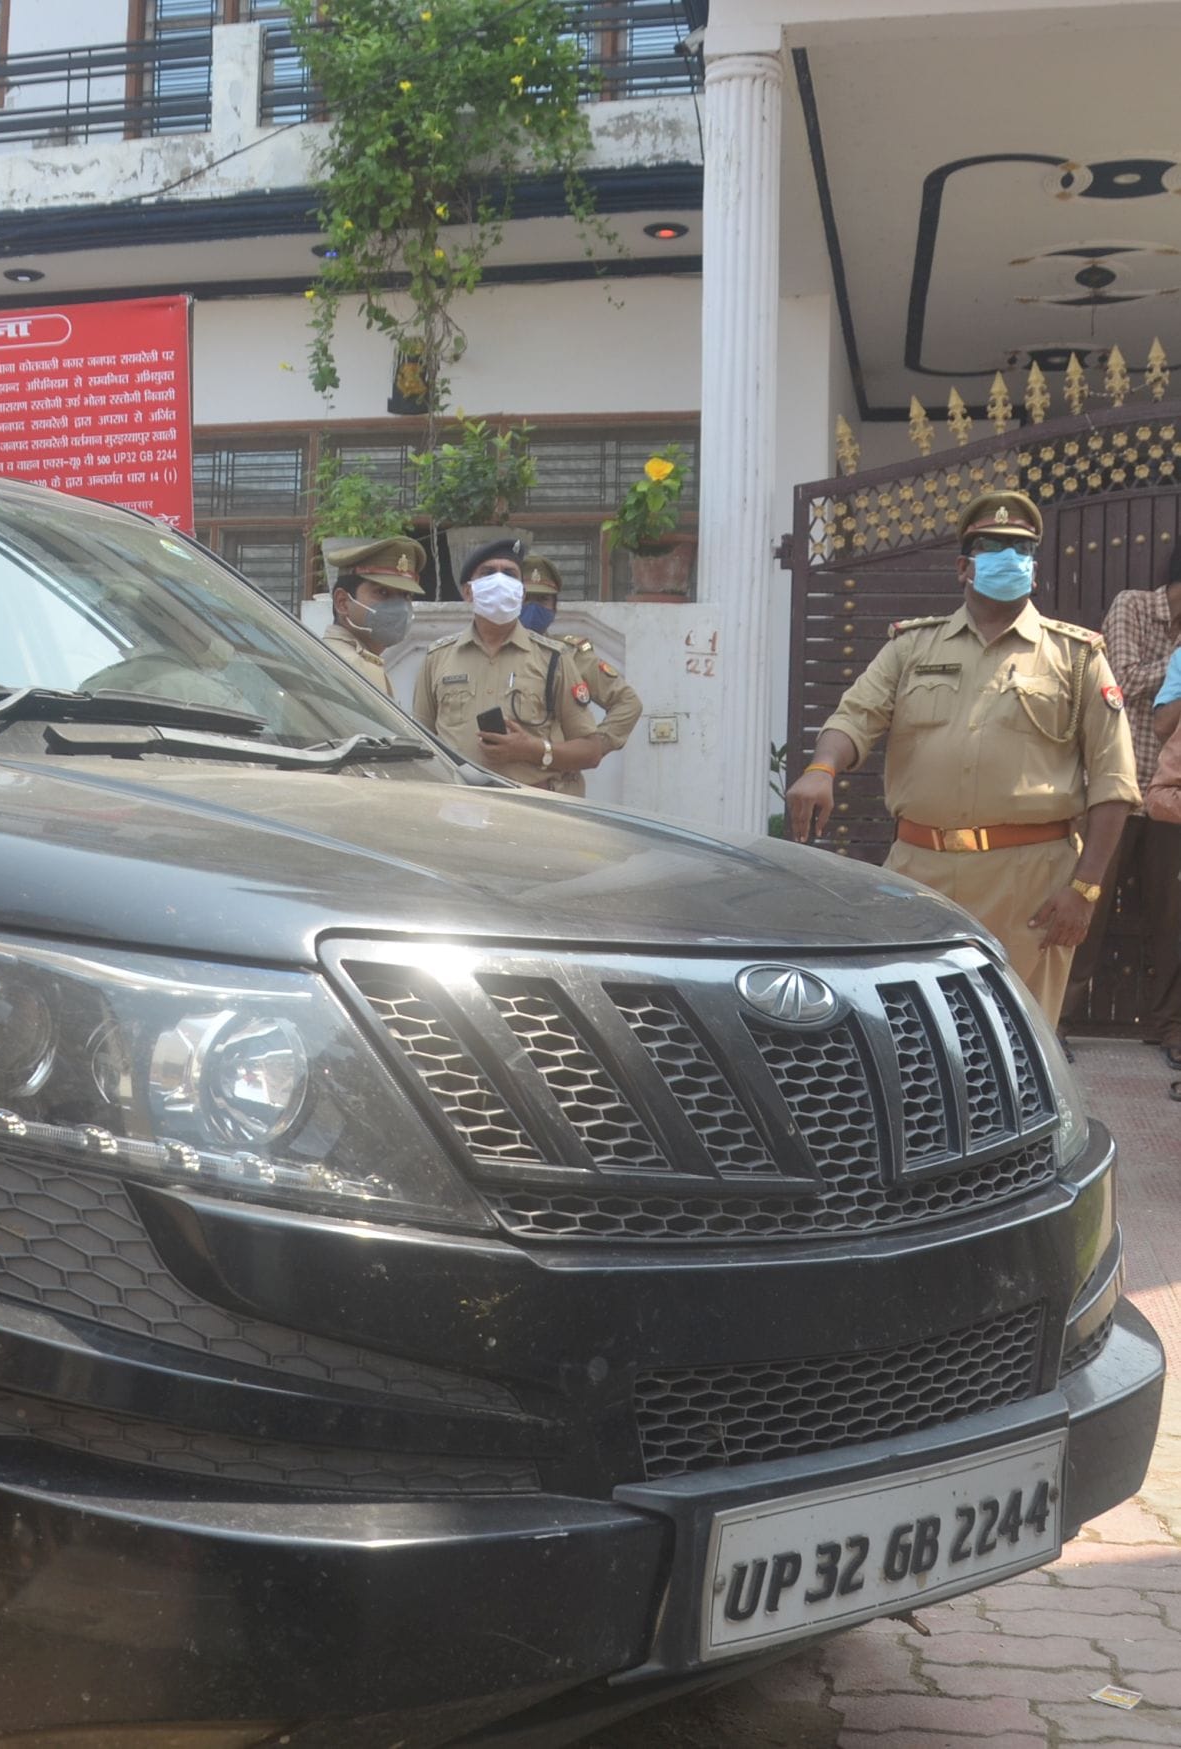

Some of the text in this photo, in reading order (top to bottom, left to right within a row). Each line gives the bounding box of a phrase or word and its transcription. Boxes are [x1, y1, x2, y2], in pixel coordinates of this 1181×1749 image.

[19, 356, 58, 371] कोतवाली
[63, 358, 84, 368] नगर
[87, 355, 116, 366] जनपद
[121, 349, 158, 364] रायबरेली
[162, 351, 175, 360] पर
[25, 377, 68, 390] अधिनियम
[74, 374, 82, 387] से
[31, 395, 62, 410] रस्तोगी
[84, 393, 106, 406] भोला
[109, 389, 141, 404] रस्तोगी
[144, 387, 175, 402] निवासी
[31, 415, 68, 429] रायबरेली
[74, 416, 91, 428] द्वारा
[134, 410, 142, 422] से
[149, 407, 176, 421] अर्जित
[0, 441, 28, 452] जनपद
[31, 434, 68, 449] रायबरेली
[71, 433, 102, 446] वर्तमान
[152, 427, 176, 441] खाली
[7, 462, 14, 472] व
[17, 460, 39, 470] वाहन
[84, 453, 94, 465] वी
[97, 455, 111, 465] 500
[113, 451, 137, 464] UP32
[139, 450, 154, 462] GB
[156, 449, 177, 461] 2244
[51, 475, 61, 488] के
[66, 476, 83, 488] द्वारा
[87, 471, 123, 485] अन्तर्गत
[127, 472, 145, 483] धारा
[150, 471, 159, 482] 14
[724, 1480, 1050, 1621] UP 32 GB 2244
